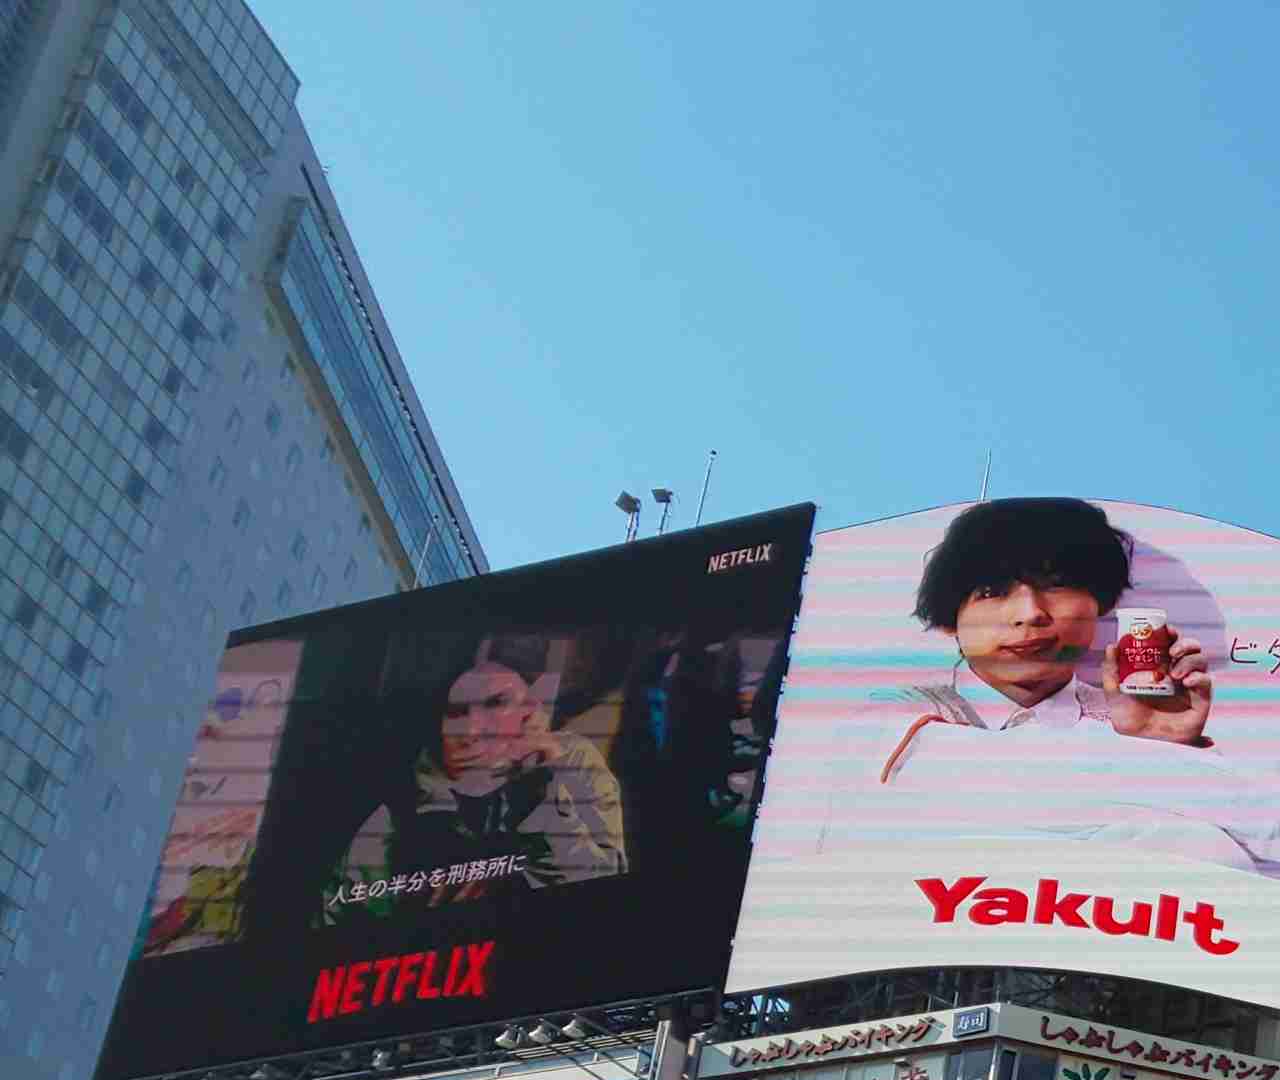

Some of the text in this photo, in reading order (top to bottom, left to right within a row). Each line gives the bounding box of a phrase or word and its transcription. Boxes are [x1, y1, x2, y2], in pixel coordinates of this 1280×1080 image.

[707, 543, 772, 573] NETFLIX
[328, 852, 526, 906] 人生の半分を刑務所に
[914, 877, 1239, 955] Yakult
[306, 941, 495, 1023] NETFLIX
[730, 1017, 936, 1067] しゃぶしゃぶバイキング
